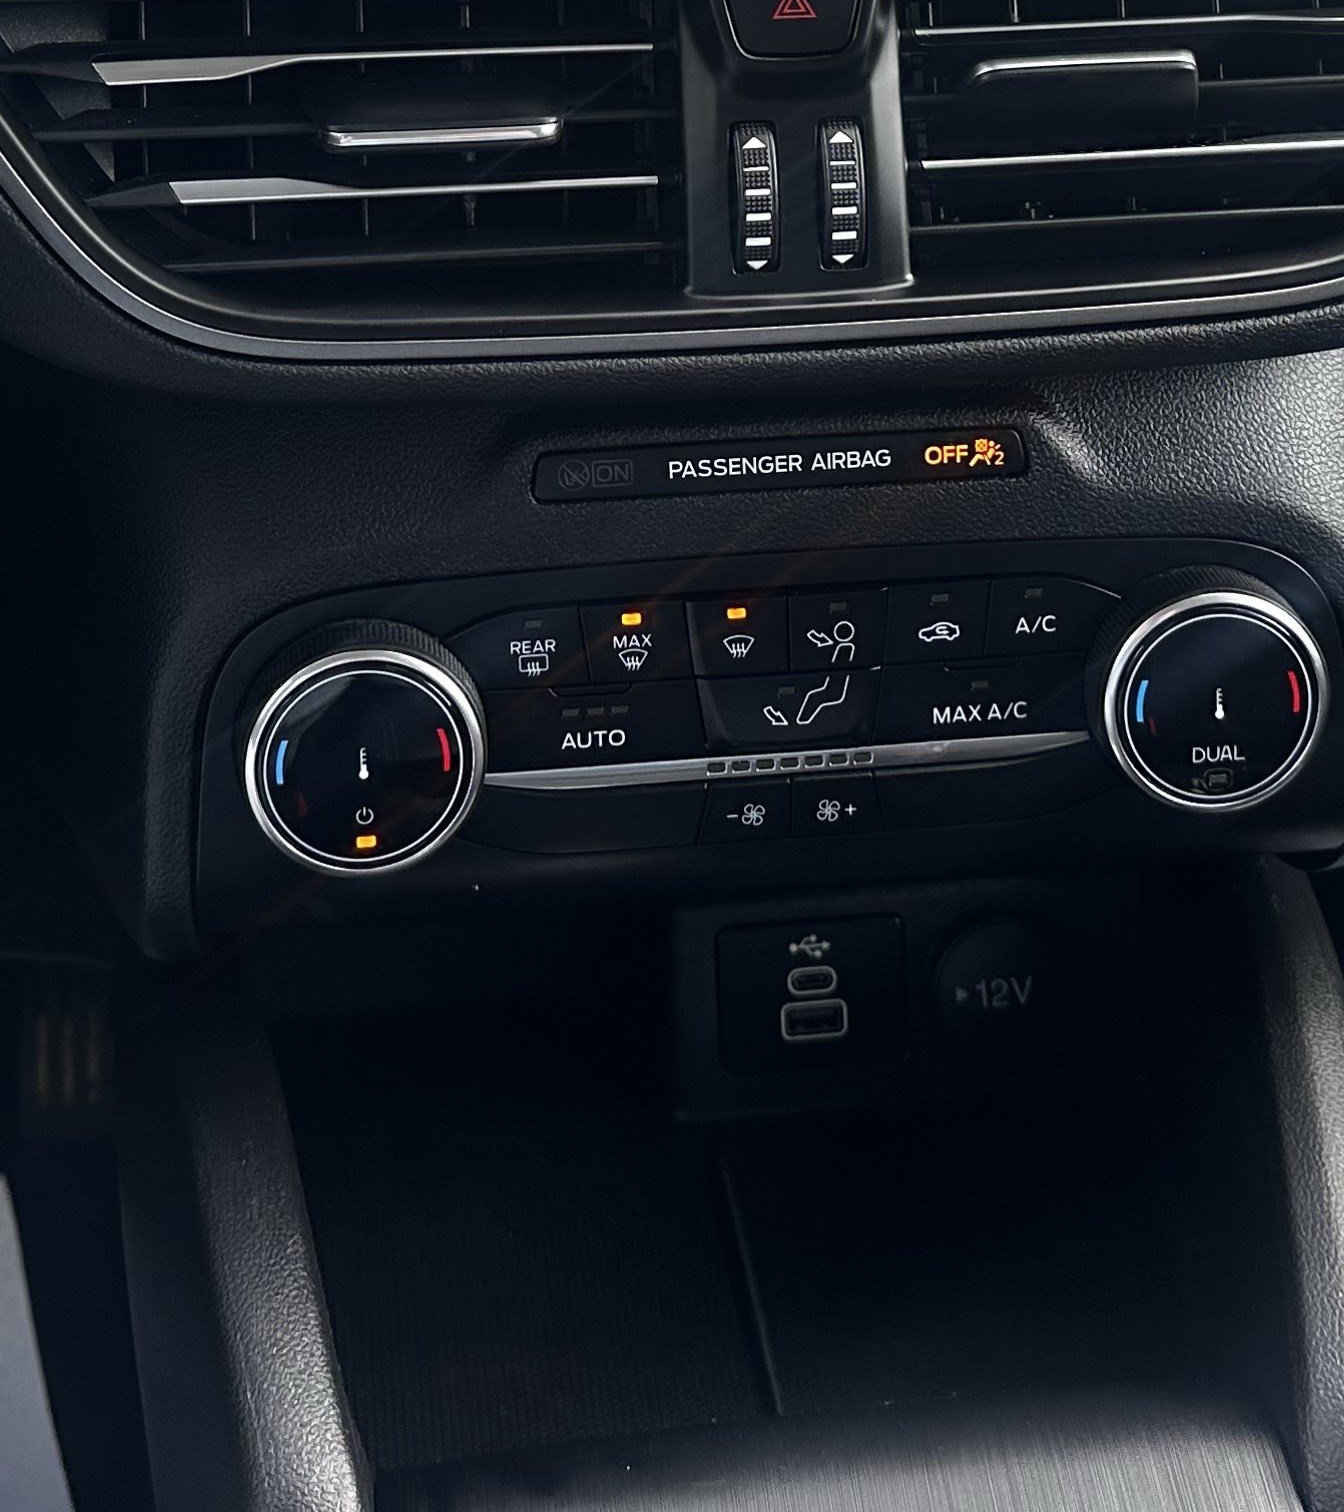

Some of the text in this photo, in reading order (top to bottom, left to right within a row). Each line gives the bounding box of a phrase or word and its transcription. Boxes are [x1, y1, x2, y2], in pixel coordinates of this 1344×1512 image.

[668, 449, 892, 480] PASSENGER AIRBAG
[924, 445, 969, 466] OFF
[597, 461, 631, 483] ON
[1015, 614, 1057, 635] A/C
[510, 638, 556, 655] REAR
[612, 633, 653, 649] MAX
[932, 700, 1028, 725] MAX A/C
[561, 729, 626, 751] AUTO
[1191, 744, 1246, 764] DUAL
[975, 974, 1033, 1009] 12V
